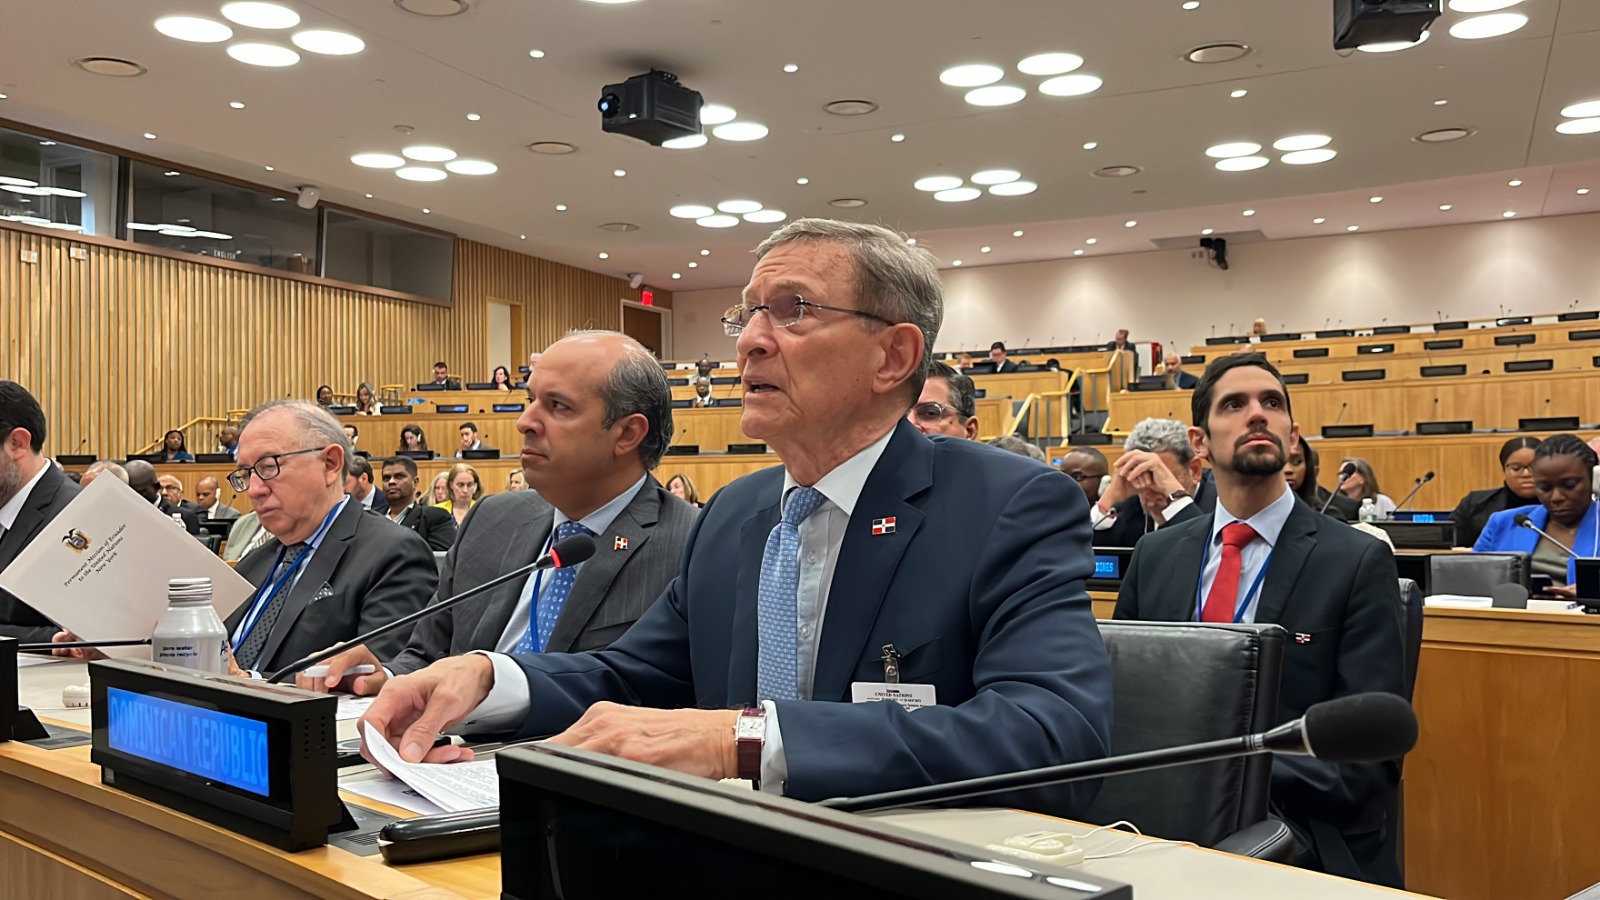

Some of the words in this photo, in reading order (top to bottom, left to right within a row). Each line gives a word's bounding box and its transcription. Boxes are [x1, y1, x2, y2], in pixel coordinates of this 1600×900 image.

[213, 249, 236, 259] ENGLISH
[64, 562, 88, 587] Permanent
[87, 546, 104, 563] Mission
[108, 524, 126, 542] Ecuador
[90, 552, 107, 568] United
[105, 536, 124, 554] Nations
[96, 563, 107, 574] New
[105, 552, 117, 563] York
[1095, 561, 1114, 573] DINES
[110, 696, 188, 764] DOMINICAN
[192, 716, 268, 787] REPUBLIC
